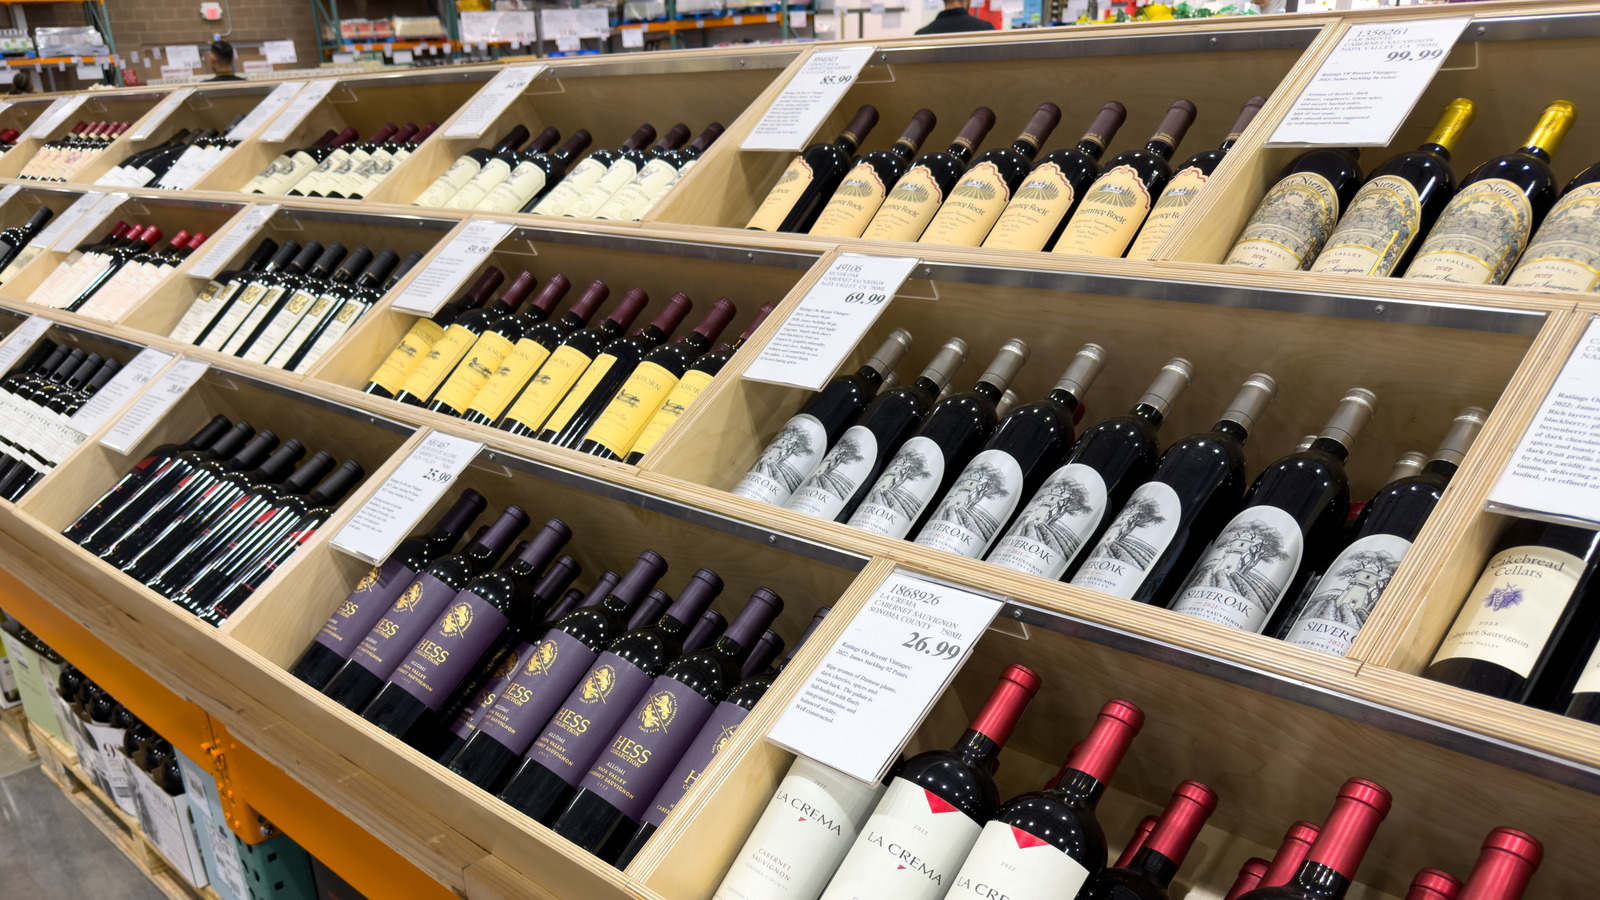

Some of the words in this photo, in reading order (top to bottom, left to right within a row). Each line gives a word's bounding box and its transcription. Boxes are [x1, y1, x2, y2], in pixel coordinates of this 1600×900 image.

[1357, 28, 1408, 37] 1356261
[1383, 49, 1443, 62] 99.99
[820, 75, 852, 85] 85.99
[1297, 175, 1329, 197] Niente
[1369, 181, 1404, 193] Niente
[1481, 183, 1520, 205] Niente
[901, 205, 920, 218] Rock
[967, 202, 986, 216] Rock
[1029, 203, 1050, 216] Rock
[1106, 209, 1127, 224] Rock
[1261, 247, 1287, 261] VALLEY
[835, 263, 863, 272] 49106
[1443, 258, 1476, 271] VALLEY
[1545, 265, 1578, 275] VALLEY
[845, 291, 886, 305] 69.99
[1557, 392, 1588, 402] Ratings
[1548, 408, 1566, 416] Rich
[1568, 411, 1591, 420] layers
[1552, 400, 1573, 408] 2022:
[1575, 404, 1600, 412] James
[1543, 416, 1588, 428] blackberry,
[1539, 424, 1587, 437] boysenberry
[1545, 433, 1563, 441] dark
[1525, 447, 1544, 455] dark
[1566, 454, 1594, 462] profile
[1530, 439, 1553, 447] spices
[1572, 446, 1596, 455] toasty
[1521, 454, 1531, 462] by
[1533, 456, 1558, 465] bright
[1559, 461, 1586, 470] acidity
[422, 468, 452, 483] 25.99
[1512, 470, 1540, 481] bodied,
[1557, 479, 1588, 488] refined
[1516, 463, 1547, 473] tannins,
[1550, 468, 1590, 480] delivering
[760, 479, 780, 497] OAK
[809, 489, 830, 504] OAK
[875, 509, 897, 525] OAK
[950, 527, 973, 547] OAK
[1028, 544, 1053, 565] OAK
[1012, 556, 1043, 574] SAUVIGNON
[1099, 560, 1126, 576] OAK
[1490, 554, 1565, 572] Cakebread
[1494, 565, 1543, 578] Cellars
[879, 592, 890, 600] LA
[891, 595, 917, 608] CREMA
[890, 583, 942, 606] 1868926
[1183, 589, 1223, 604] SILVER
[1224, 595, 1252, 618] OAK
[874, 599, 914, 615] CABERNET
[912, 610, 959, 629] SAUVIGNON
[1206, 609, 1243, 630] SAUVIGNON
[868, 605, 899, 620] SONOMA
[900, 615, 934, 630] COUNTY
[939, 627, 963, 640] 750ML
[1303, 621, 1351, 644] SILVER
[1447, 630, 1479, 641] Cabernet
[1481, 629, 1529, 648] Sauvignon
[417, 638, 450, 663] HESS
[901, 631, 961, 660] 26.99
[1293, 640, 1329, 650] CABERNET
[1328, 638, 1344, 648] 2021
[415, 648, 440, 666] COLLECTION
[841, 641, 861, 652] Ratings
[861, 648, 870, 656] On
[869, 651, 888, 661] Recent
[889, 657, 913, 671] Vintages:
[410, 660, 427, 672] ALLOMI
[825, 662, 837, 671] Ripe
[837, 668, 854, 677] aromas
[849, 653, 864, 662] James
[864, 659, 886, 671] Suckling
[892, 669, 908, 678] Points
[411, 668, 427, 680] VALLEY
[820, 669, 832, 678] dark
[832, 674, 852, 686] cherries,
[853, 682, 867, 691] spices
[867, 687, 878, 695] and
[408, 673, 433, 692] SAUVIGNON
[843, 686, 852, 694] The
[800, 697, 821, 709] balanced
[805, 690, 829, 703] integrated
[835, 693, 846, 701] with
[846, 697, 860, 707] finely
[555, 707, 591, 733] HESS
[806, 708, 834, 724] constructed.
[491, 716, 516, 734] SAUVIGNON
[553, 719, 581, 737] COLLECTION
[548, 731, 566, 744] ALLOMI
[549, 740, 566, 753] VALLEY
[612, 735, 652, 764] HESS
[545, 745, 574, 767] SAUVIGNON
[610, 747, 641, 768] COLLECTION
[606, 761, 626, 775] ALLOMI
[609, 771, 627, 785] VALLEY
[814, 779, 827, 789] 2022
[604, 777, 635, 799] SAUVIGNON
[776, 790, 788, 803] LA
[790, 797, 841, 836] CREMA
[913, 824, 929, 835] 2022
[751, 853, 791, 881] SAUVIGNON
[758, 847, 792, 872] CABERNET
[867, 831, 883, 848] LA
[887, 842, 942, 887] CREMA
[1000, 861, 1017, 872] 2022
[745, 861, 764, 877] SONOMA
[765, 873, 789, 892] COUNTY
[956, 876, 971, 890] LA
